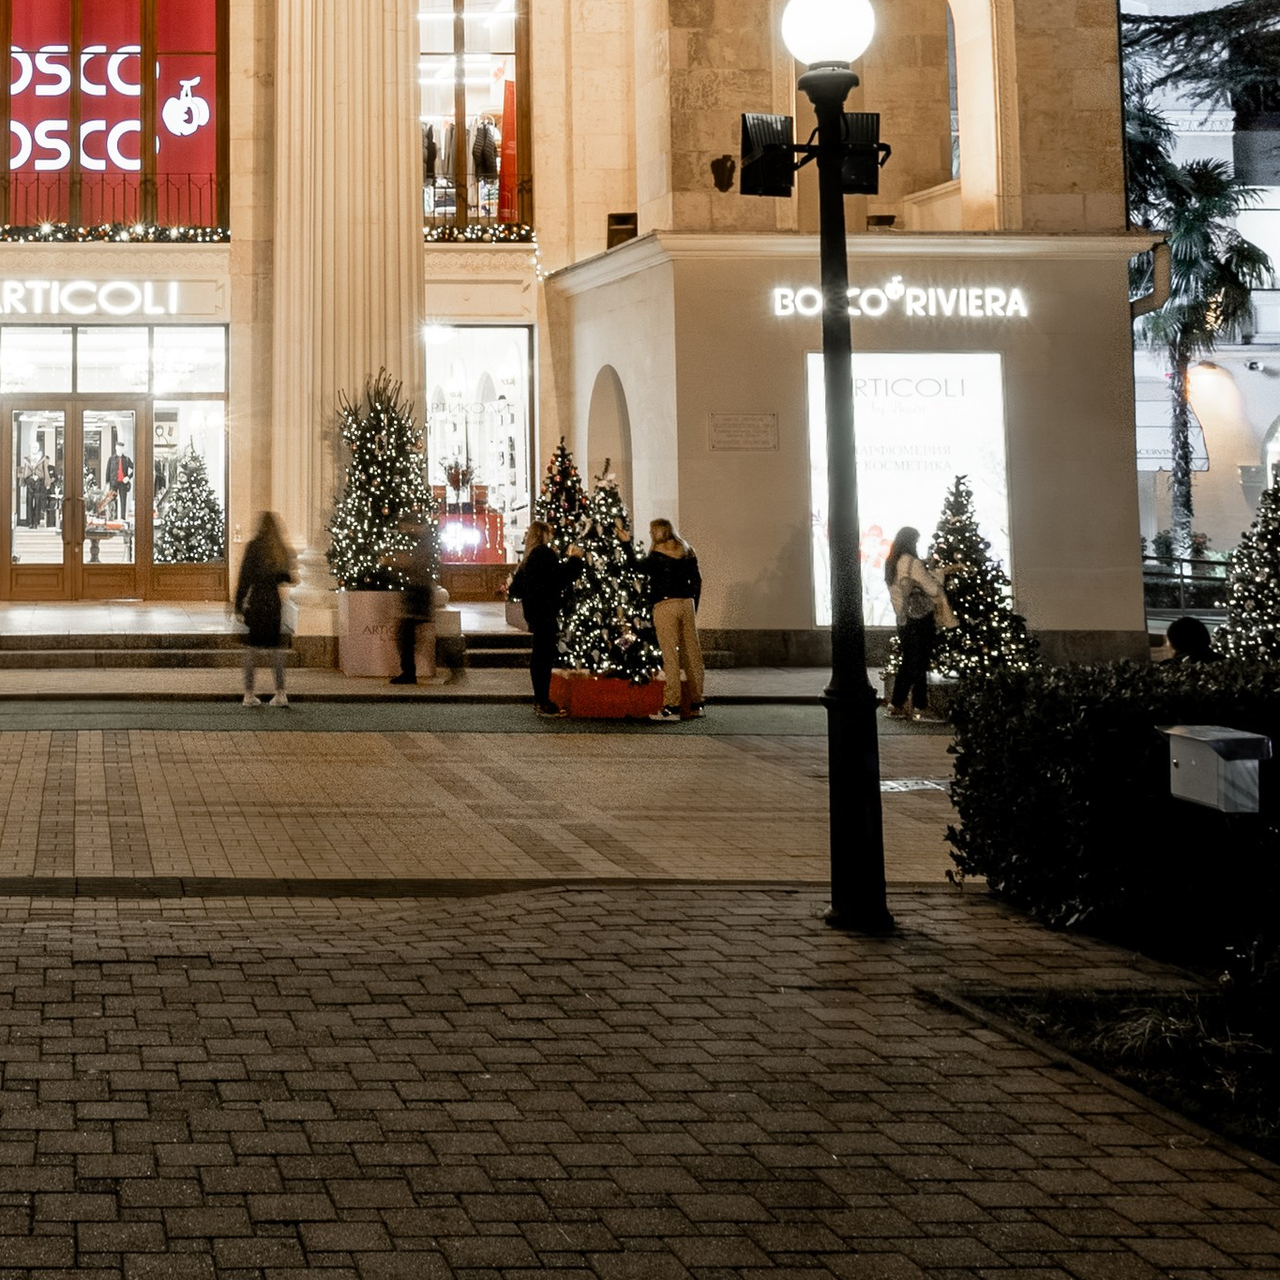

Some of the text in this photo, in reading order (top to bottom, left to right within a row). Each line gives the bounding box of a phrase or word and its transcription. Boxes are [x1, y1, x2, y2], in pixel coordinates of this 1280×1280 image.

[773, 287, 1028, 317] BOCO RIVIERA
[852, 377, 965, 397] RTICOLI
